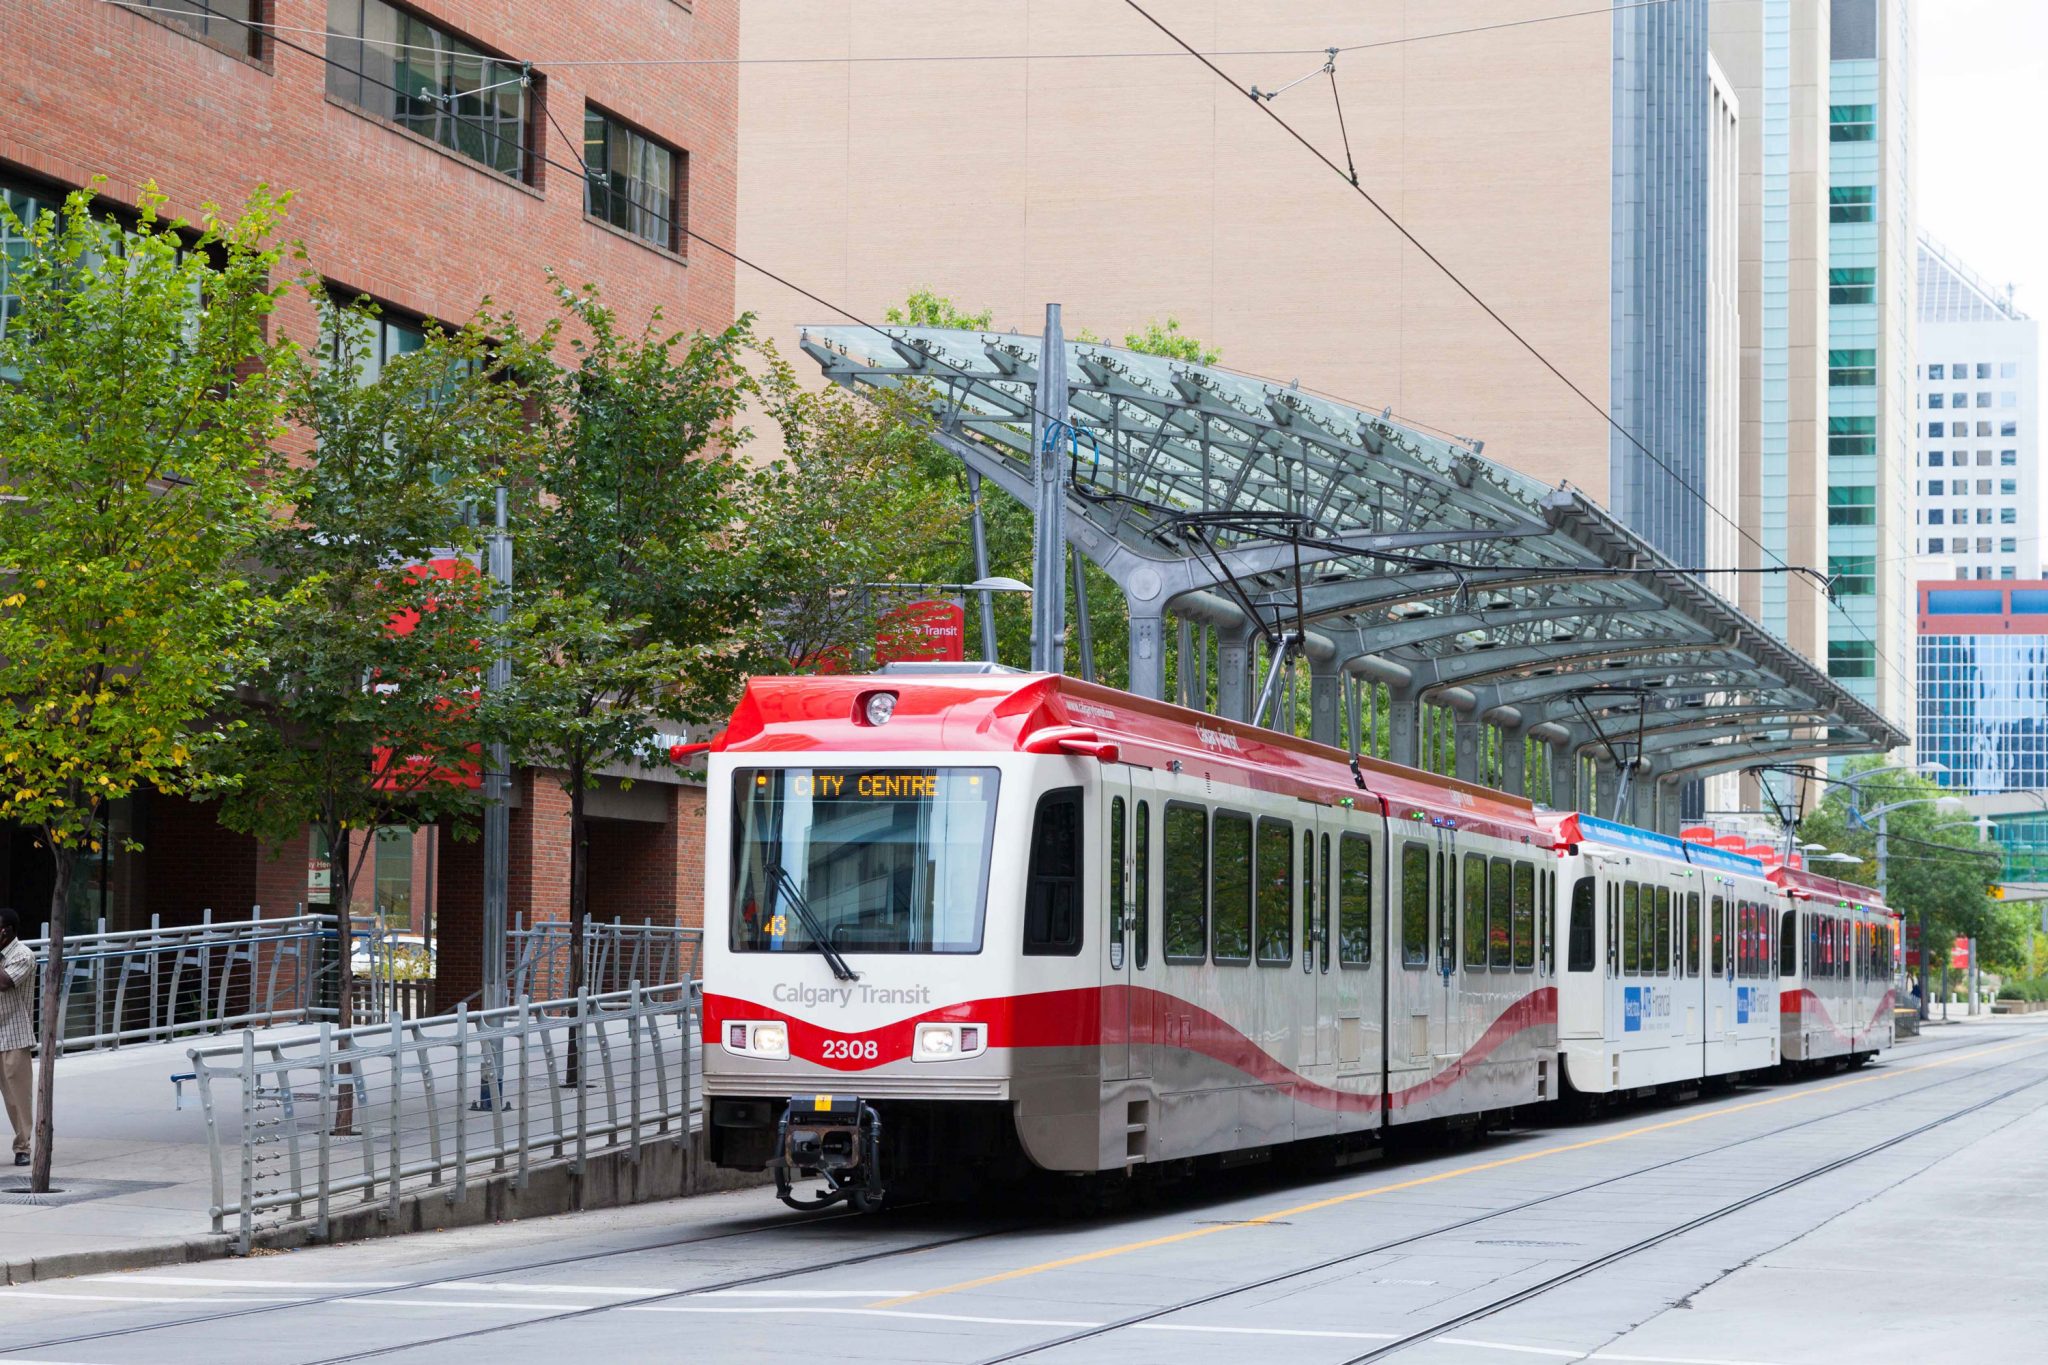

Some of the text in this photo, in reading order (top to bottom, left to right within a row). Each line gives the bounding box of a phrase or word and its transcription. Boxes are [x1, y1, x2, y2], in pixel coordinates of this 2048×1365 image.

[924, 626, 958, 636] Transit
[794, 775, 939, 797] CITY CENTRE
[764, 915, 787, 937] 43
[773, 983, 931, 1008] Calgary Transit
[822, 1039, 879, 1060] 2308
